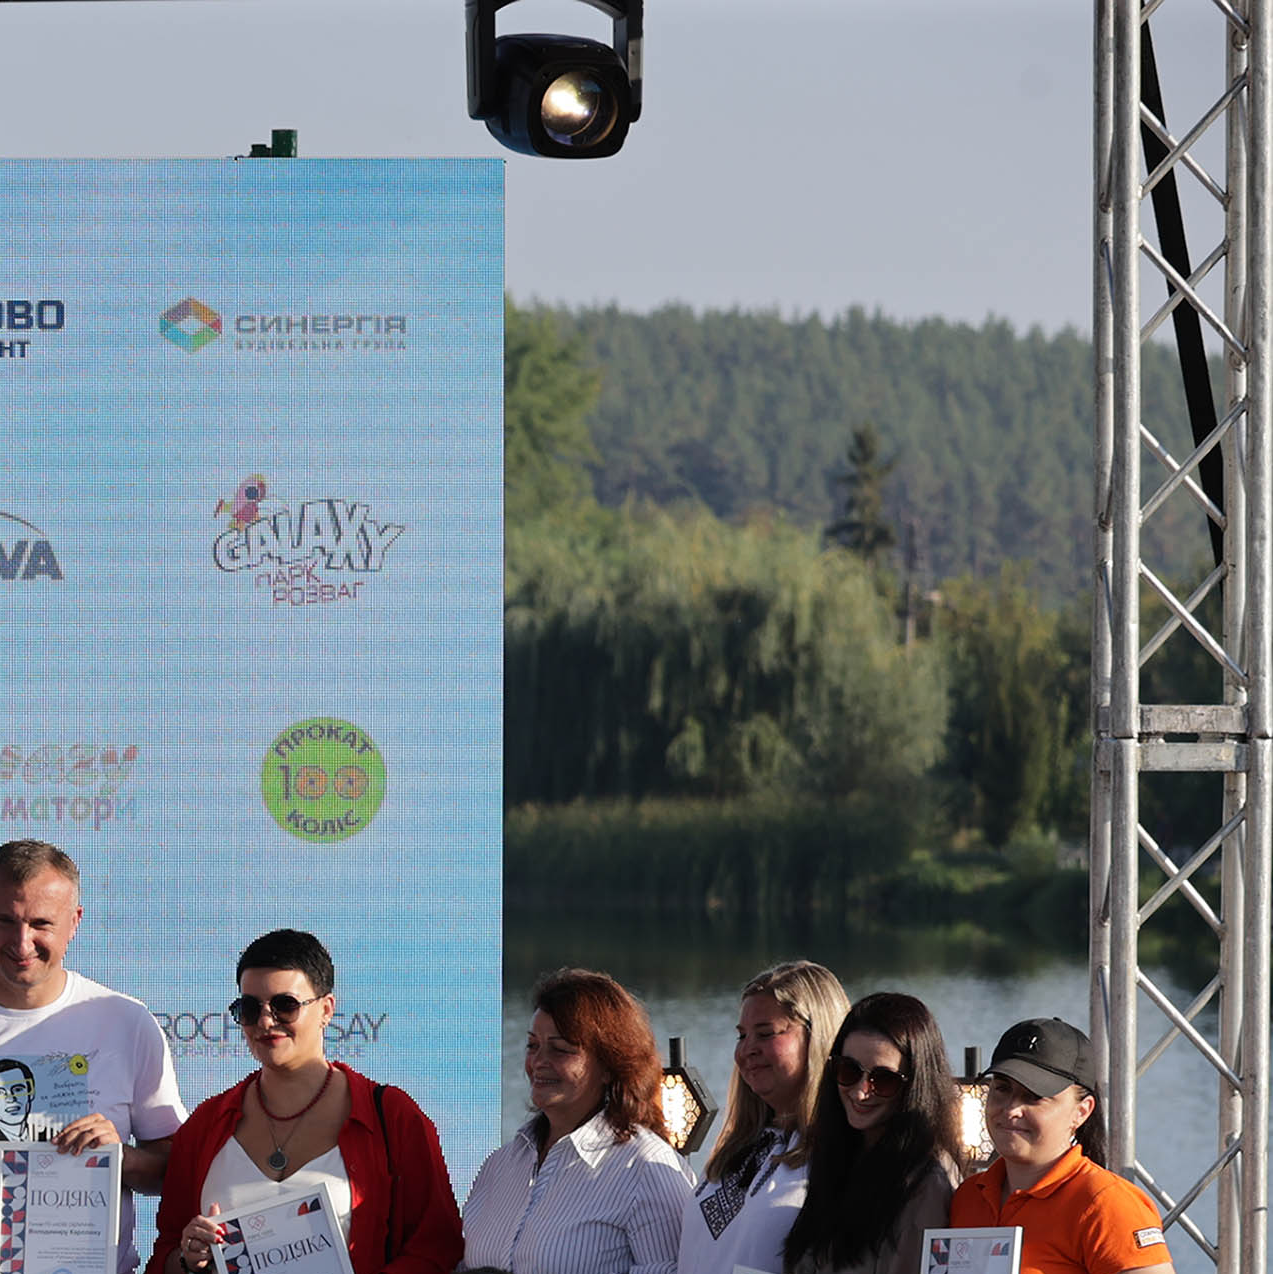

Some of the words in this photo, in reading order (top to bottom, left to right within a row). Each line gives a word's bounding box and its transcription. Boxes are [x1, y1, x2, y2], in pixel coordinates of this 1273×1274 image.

[235, 314, 406, 335] СИНЕРГІЯ
[274, 725, 374, 759] ПРОКАТ
[30, 1189, 108, 1209] ПОДЯКА
[253, 1233, 333, 1271] ПОДЯКА
